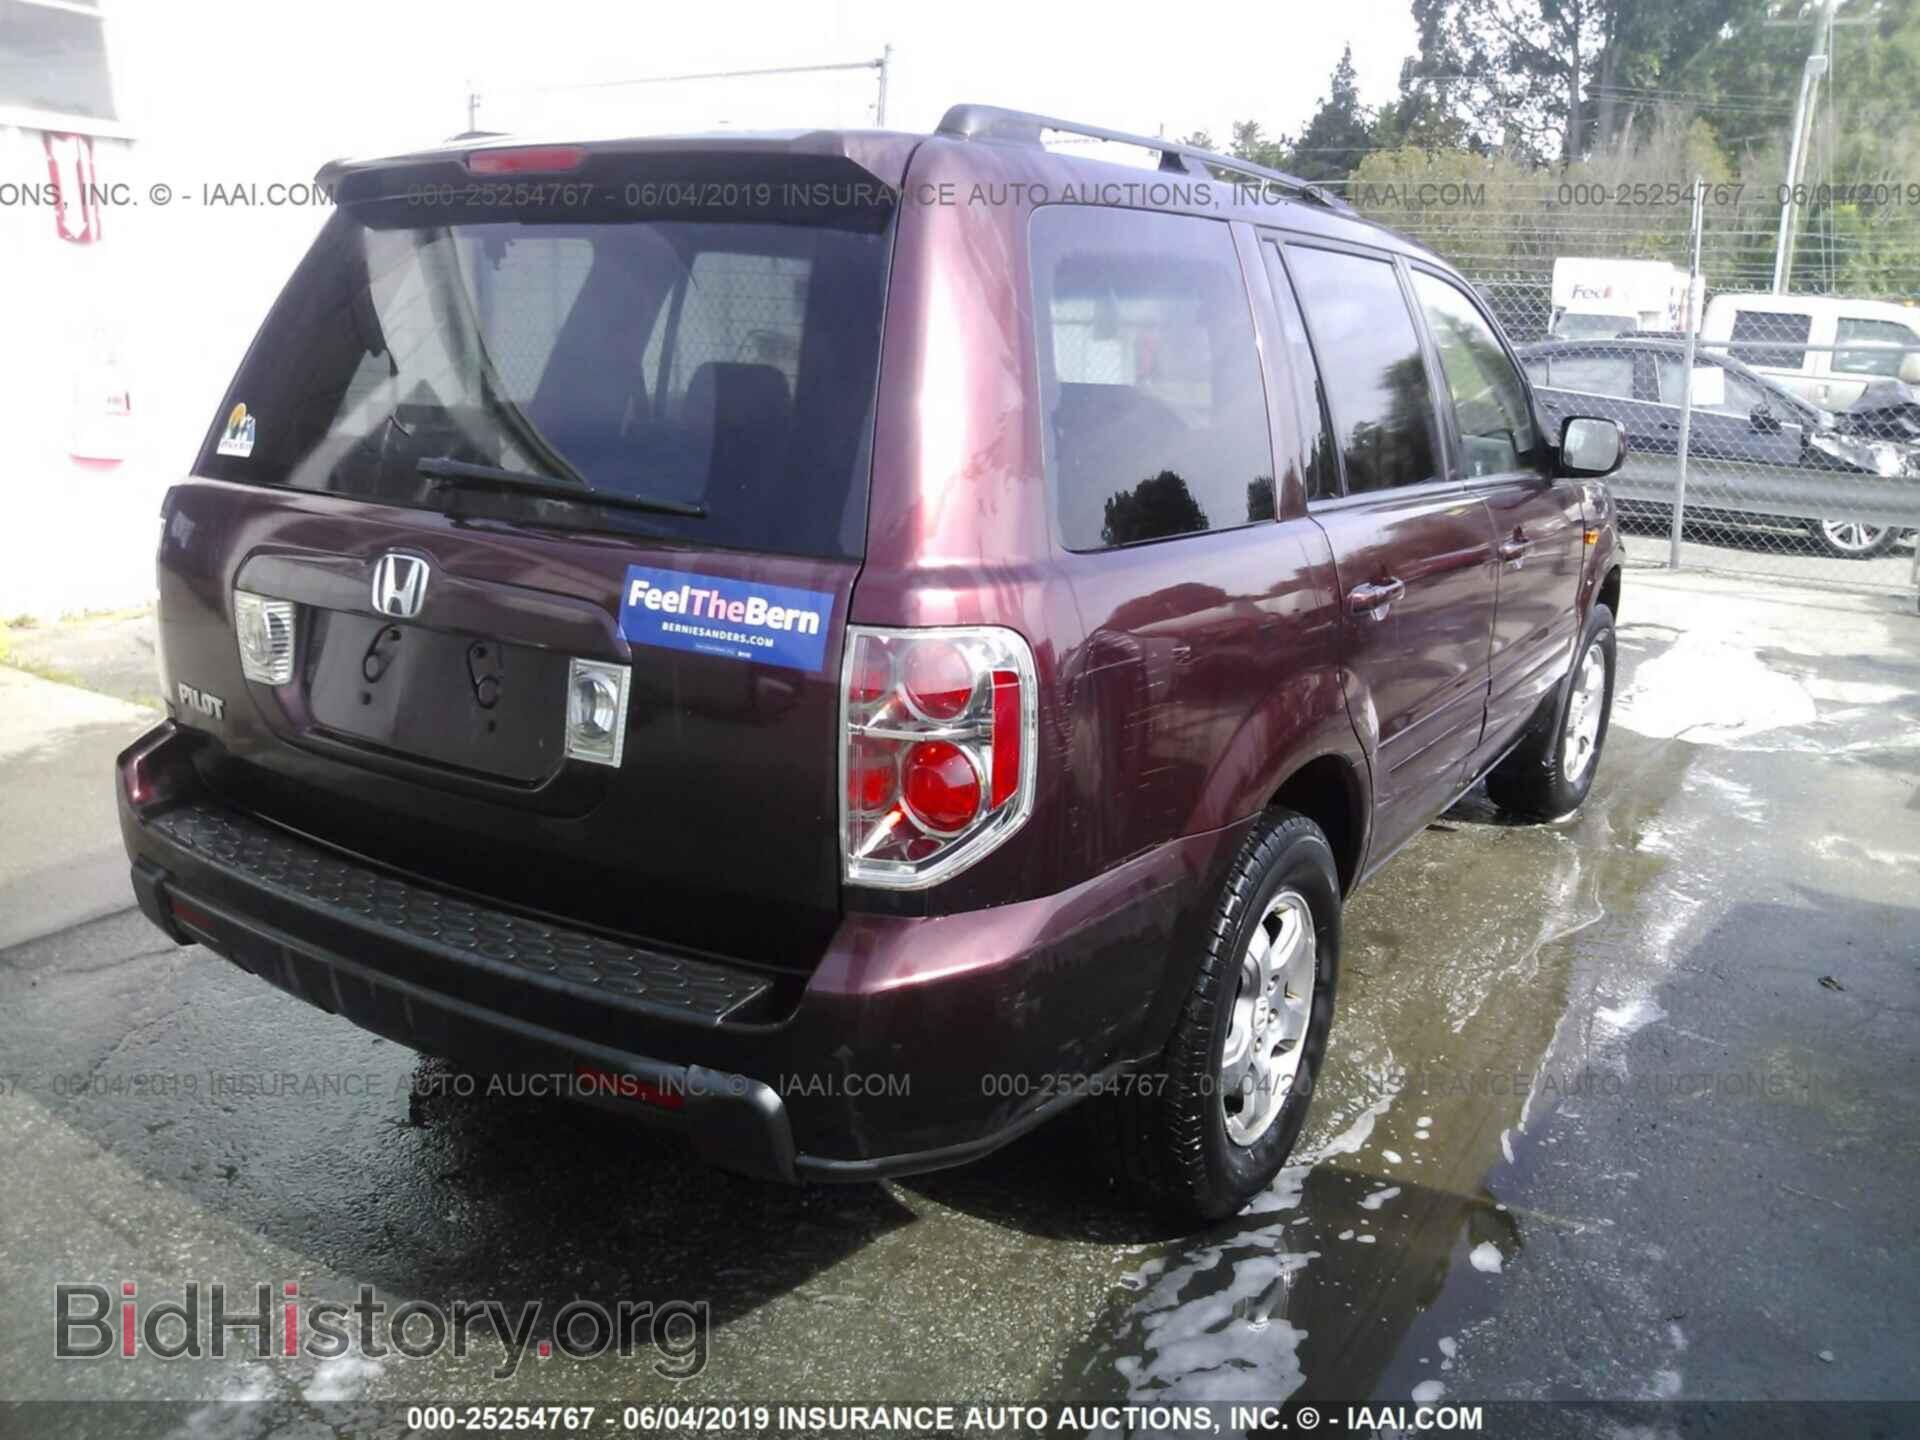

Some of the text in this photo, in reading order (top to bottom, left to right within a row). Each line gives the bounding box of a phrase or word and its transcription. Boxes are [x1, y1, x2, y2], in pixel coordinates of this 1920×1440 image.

[628, 579, 820, 635] FeelTheBern
[661, 621, 774, 648] BERNIESANDERS.COM
[178, 682, 225, 721] PILOT
